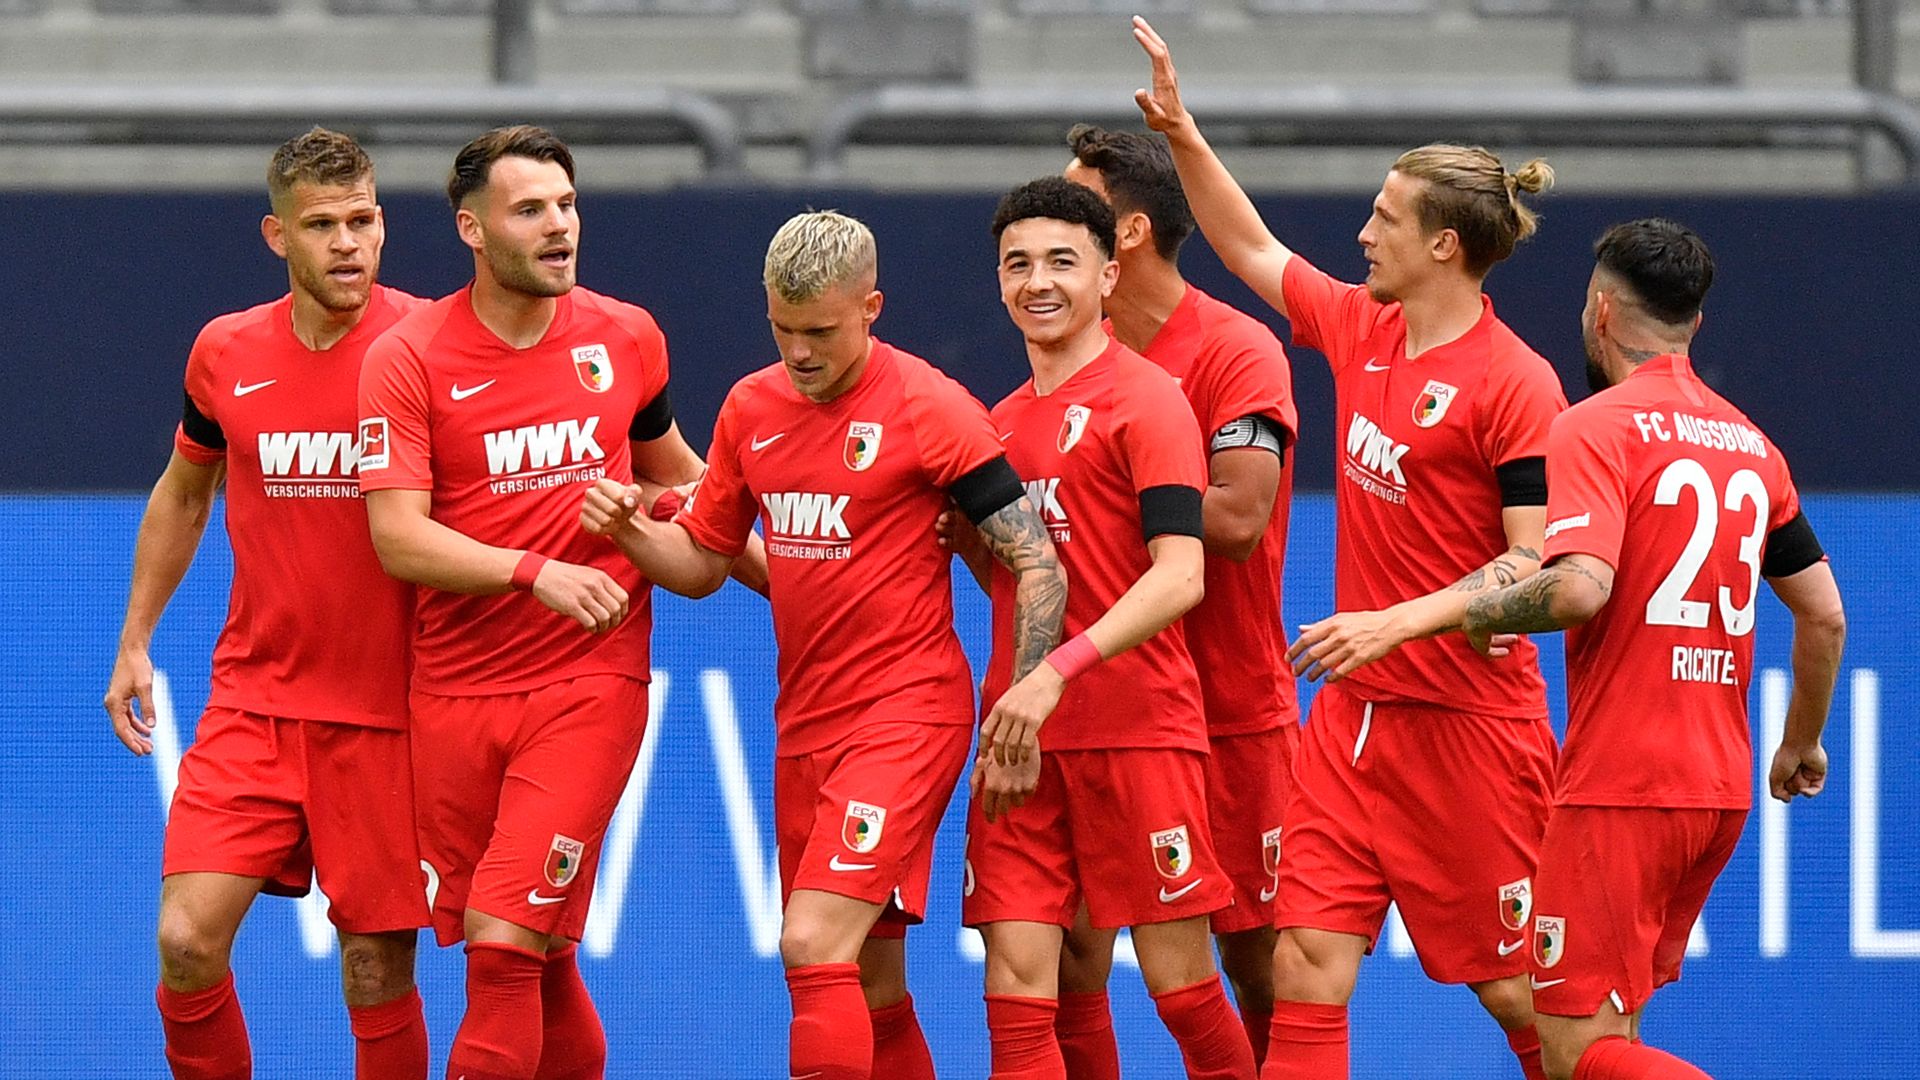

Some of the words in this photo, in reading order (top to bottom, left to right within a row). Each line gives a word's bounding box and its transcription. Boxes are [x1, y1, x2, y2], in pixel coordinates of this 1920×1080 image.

[484, 416, 606, 475] WWK
[1347, 411, 1410, 486] WWK
[1633, 411, 1671, 443] FC
[258, 432, 360, 475] WWK
[264, 485, 365, 499] VERSICHERUNG
[490, 467, 606, 495] VERSICHERUNGEN
[761, 492, 852, 538] WWK
[1645, 458, 1770, 637] 23
[1672, 646, 1738, 686] RICHTE
